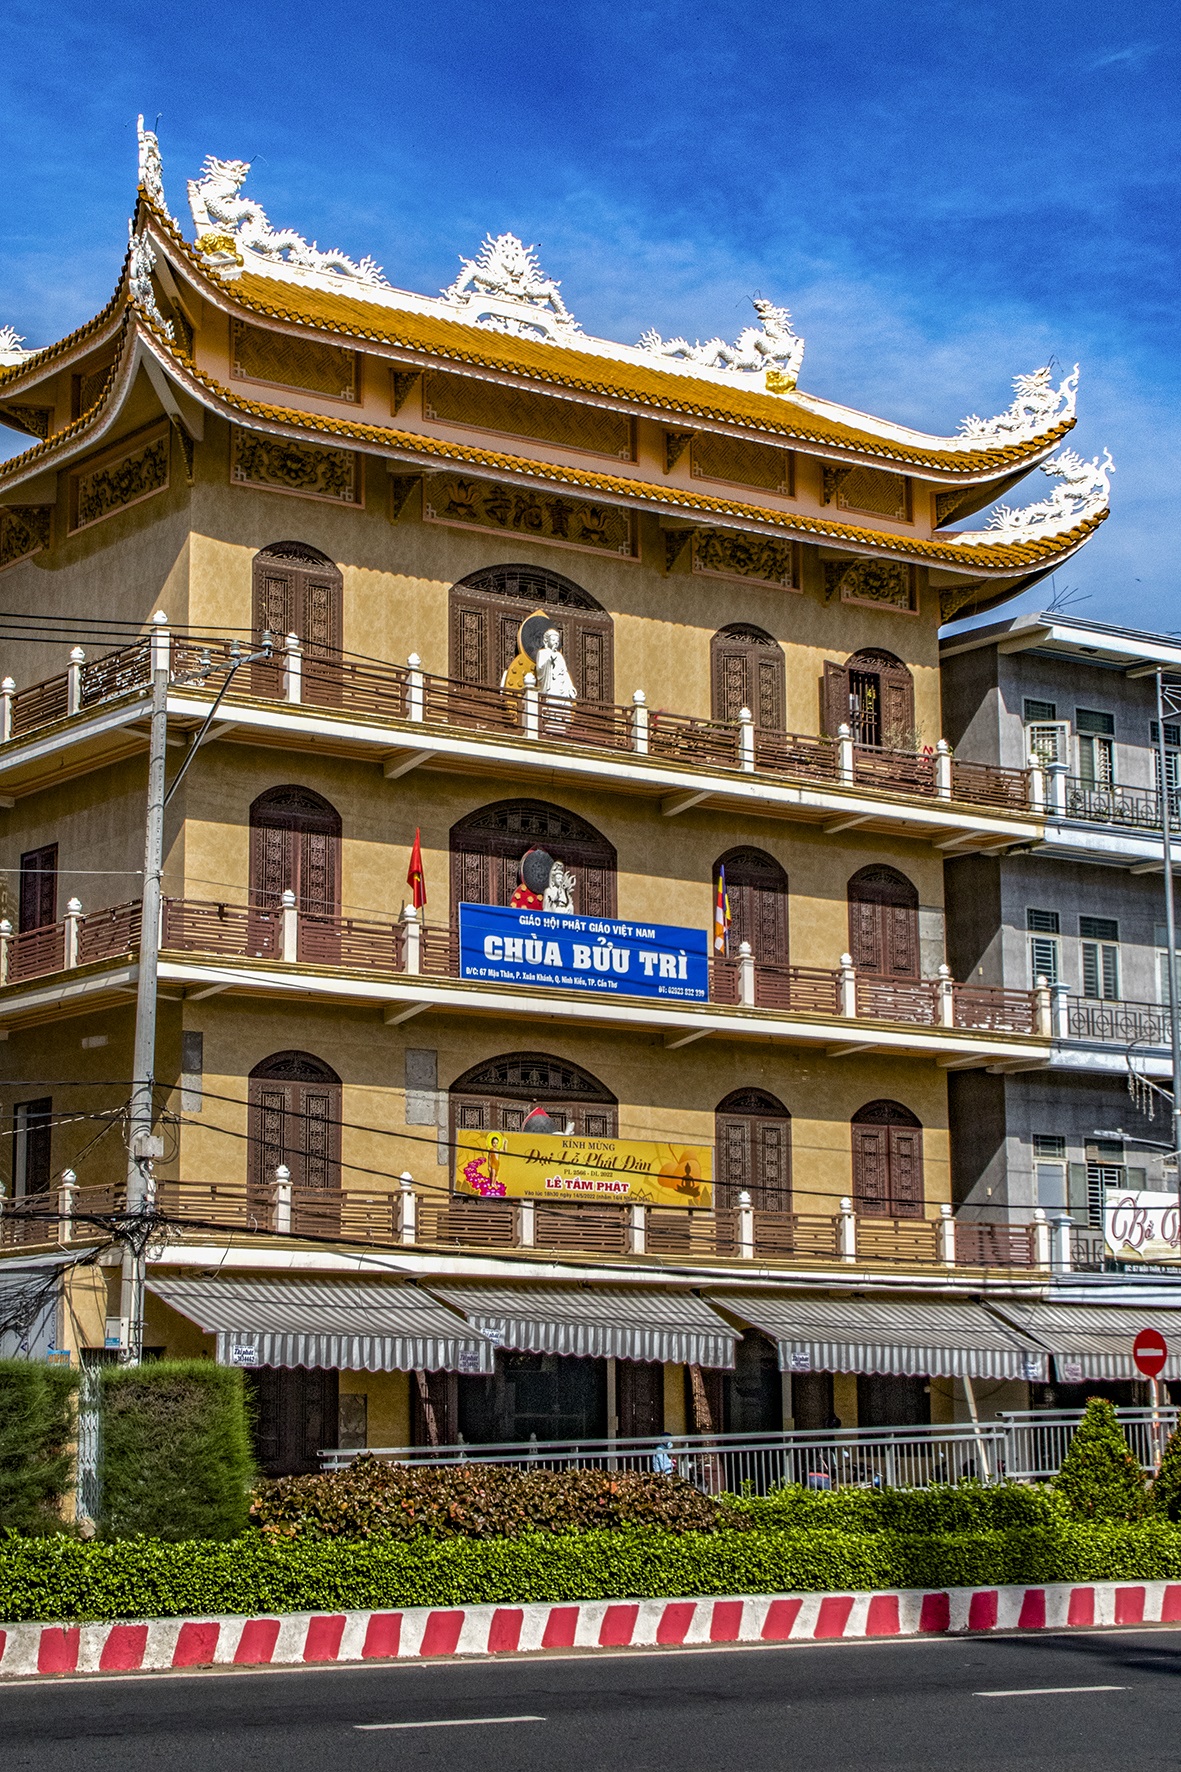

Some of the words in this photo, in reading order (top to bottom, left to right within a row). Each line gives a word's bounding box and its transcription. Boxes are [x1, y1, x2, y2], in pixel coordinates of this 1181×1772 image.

[519, 914, 541, 926] GIÁO
[543, 916, 560, 930] HỘI
[562, 919, 587, 932] PHẬT
[589, 921, 611, 934] GIÁO
[612, 924, 633, 937] VIỆT
[635, 927, 656, 938] NAM
[483, 933, 563, 967] CHÙA
[573, 936, 630, 974] BỬU
[639, 949, 688, 980] TRÌ
[479, 967, 487, 976] 67
[488, 968, 499, 978] Mậu
[522, 971, 536, 981] Xuân
[562, 975, 573, 984] Ninh
[562, 1139, 586, 1149] KÍNH
[588, 1140, 615, 1151] MỪNG
[524, 1148, 554, 1166] Đại
[557, 1150, 580, 1167] Lễ
[583, 1152, 621, 1169] Phật
[546, 1176, 562, 1188] LỄ
[596, 1181, 629, 1194] PHẬT
